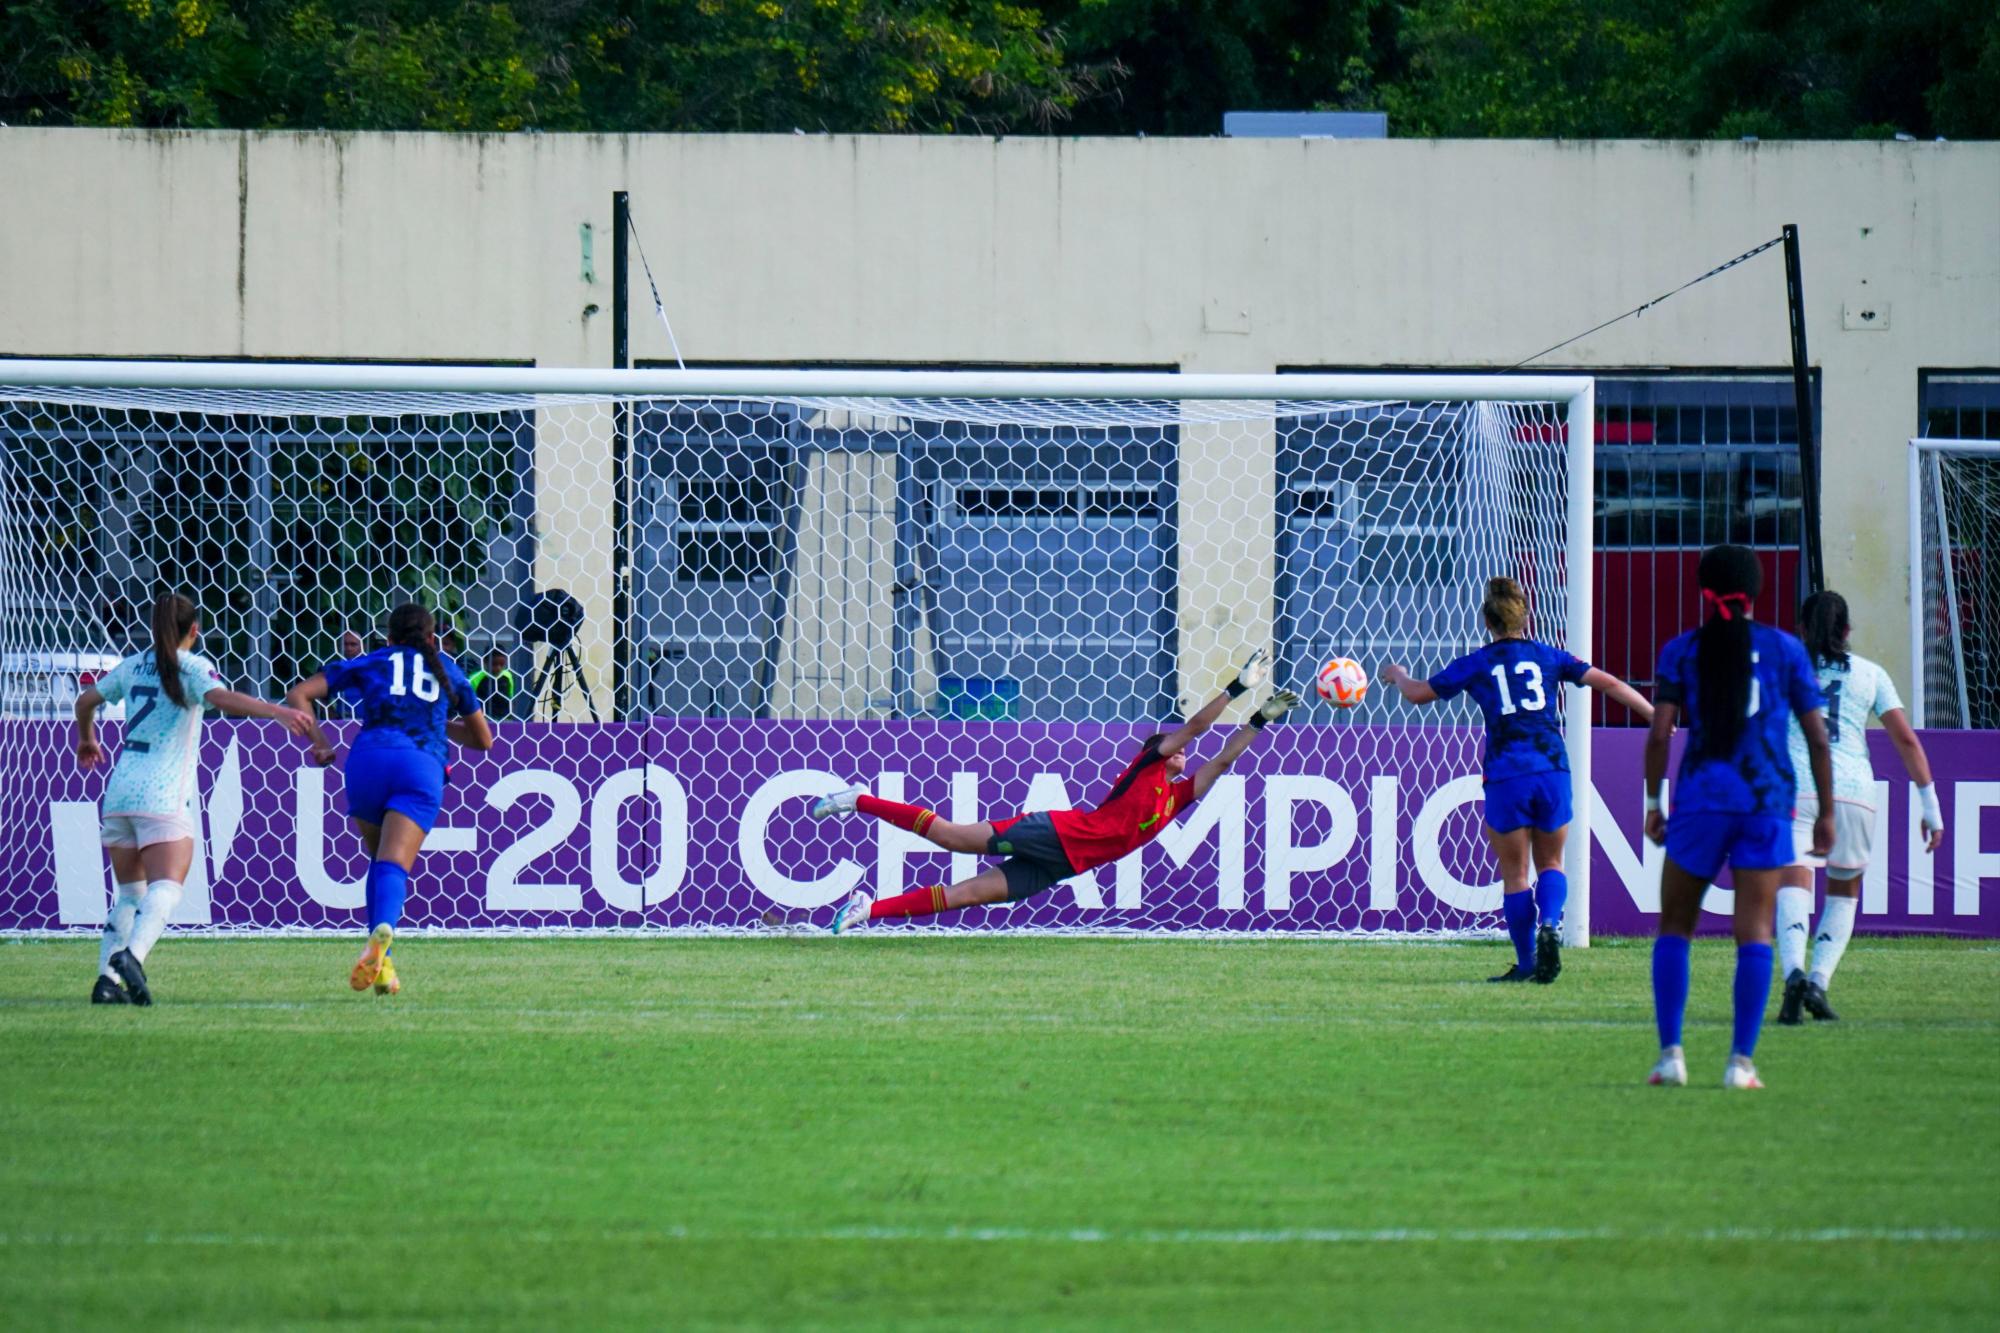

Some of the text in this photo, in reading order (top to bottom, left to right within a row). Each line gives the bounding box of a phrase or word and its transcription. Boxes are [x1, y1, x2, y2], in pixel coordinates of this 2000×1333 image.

[388, 651, 440, 703] 16
[1491, 661, 1546, 715] 13
[124, 685, 159, 754] 2
[296, 763, 688, 912] U-20
[739, 768, 2000, 916] CHAMPIONIP
